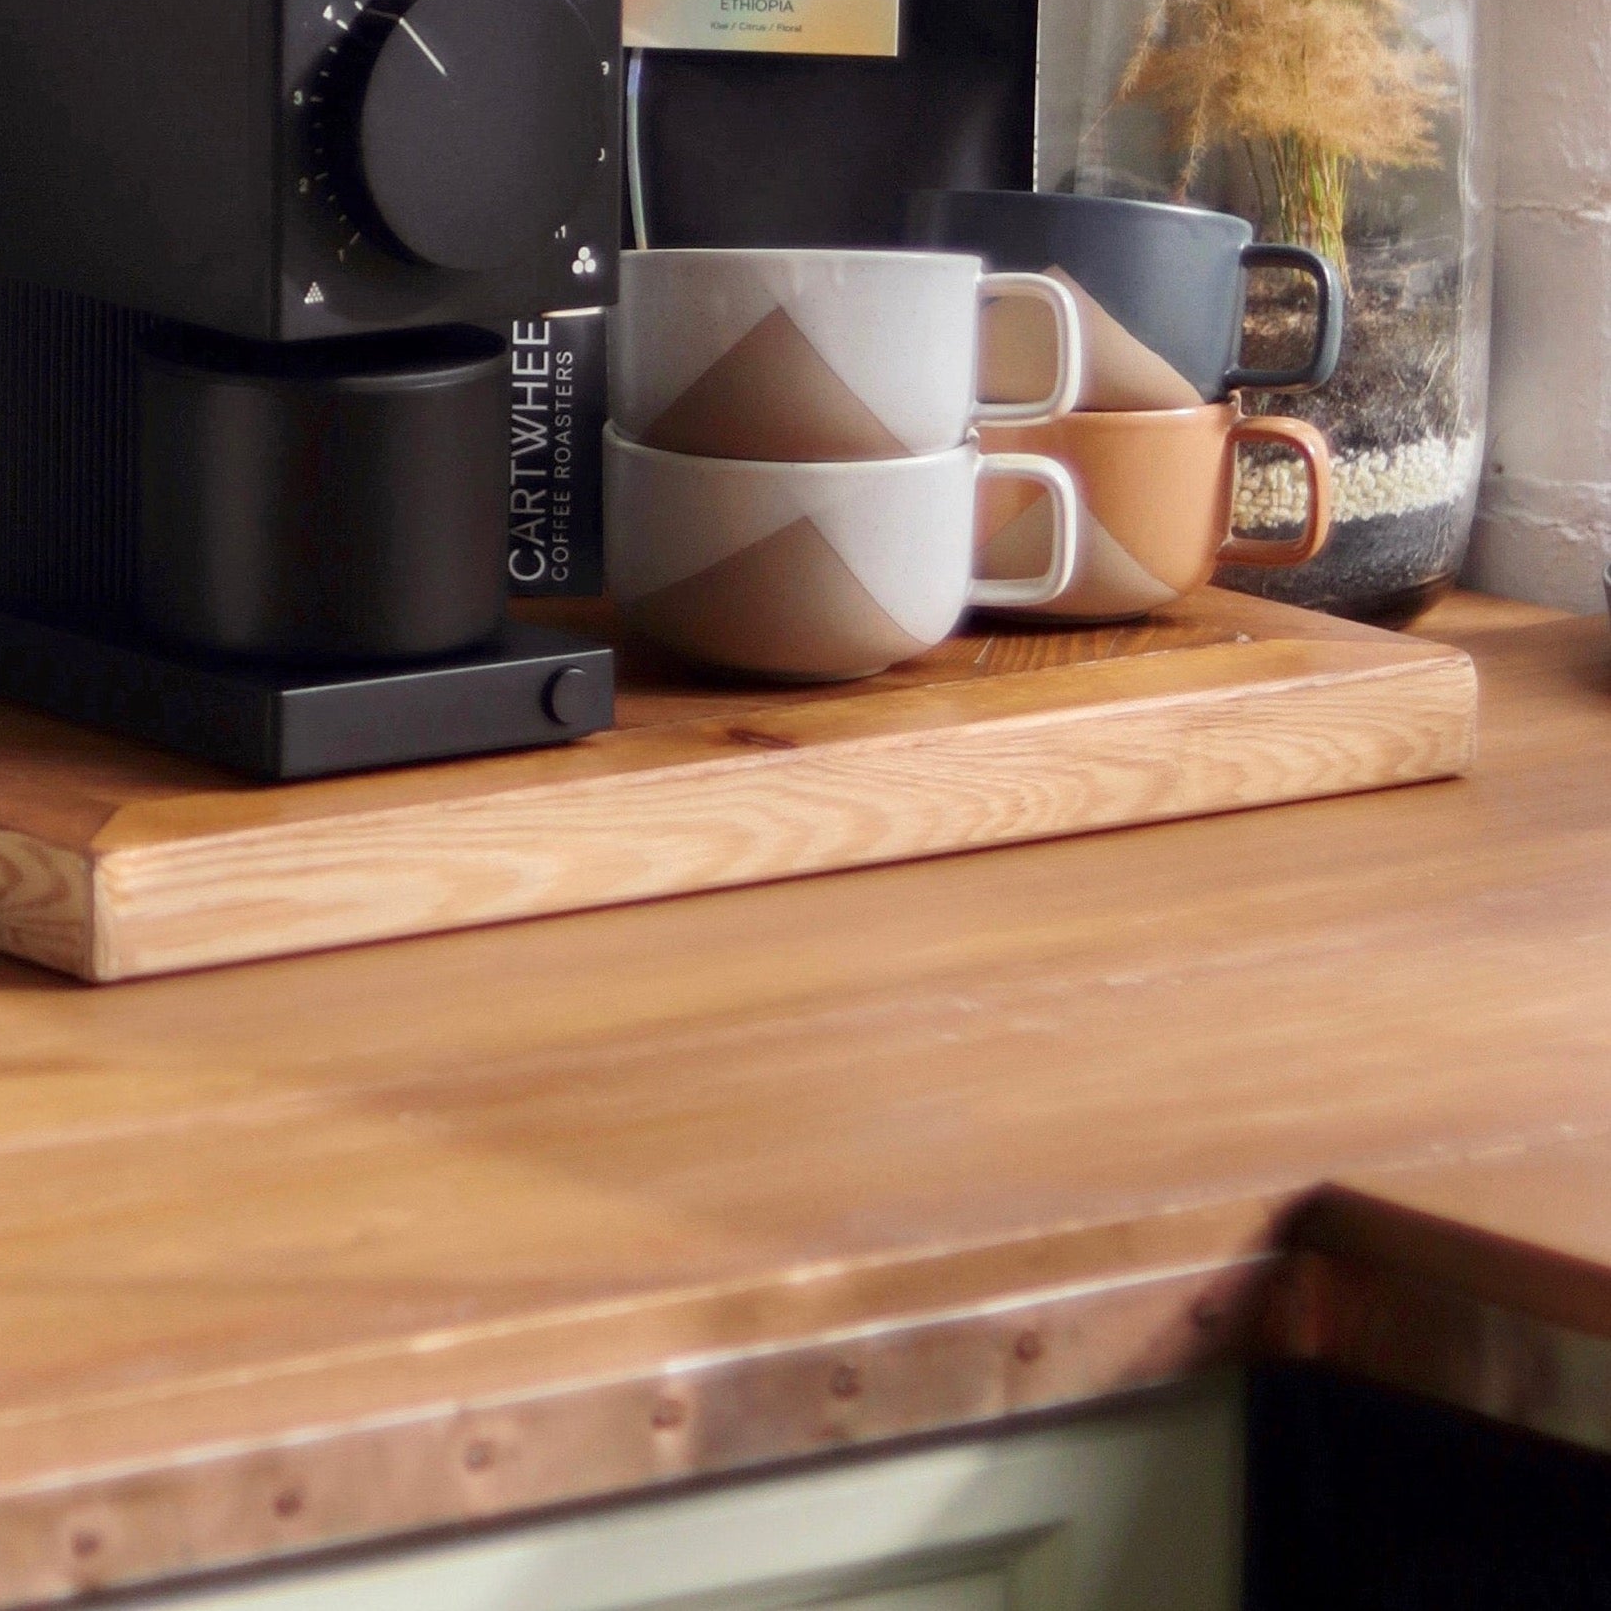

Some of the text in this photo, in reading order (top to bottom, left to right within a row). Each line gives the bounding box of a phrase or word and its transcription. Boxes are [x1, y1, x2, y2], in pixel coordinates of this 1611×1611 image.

[322, 5, 332, 20] 4
[739, 22, 766, 31] Citrus
[776, 23, 802, 32] Floral
[294, 91, 303, 105] 3
[508, 320, 550, 581] CARTWHEE
[551, 350, 574, 582] COFFEE ROASTERS
